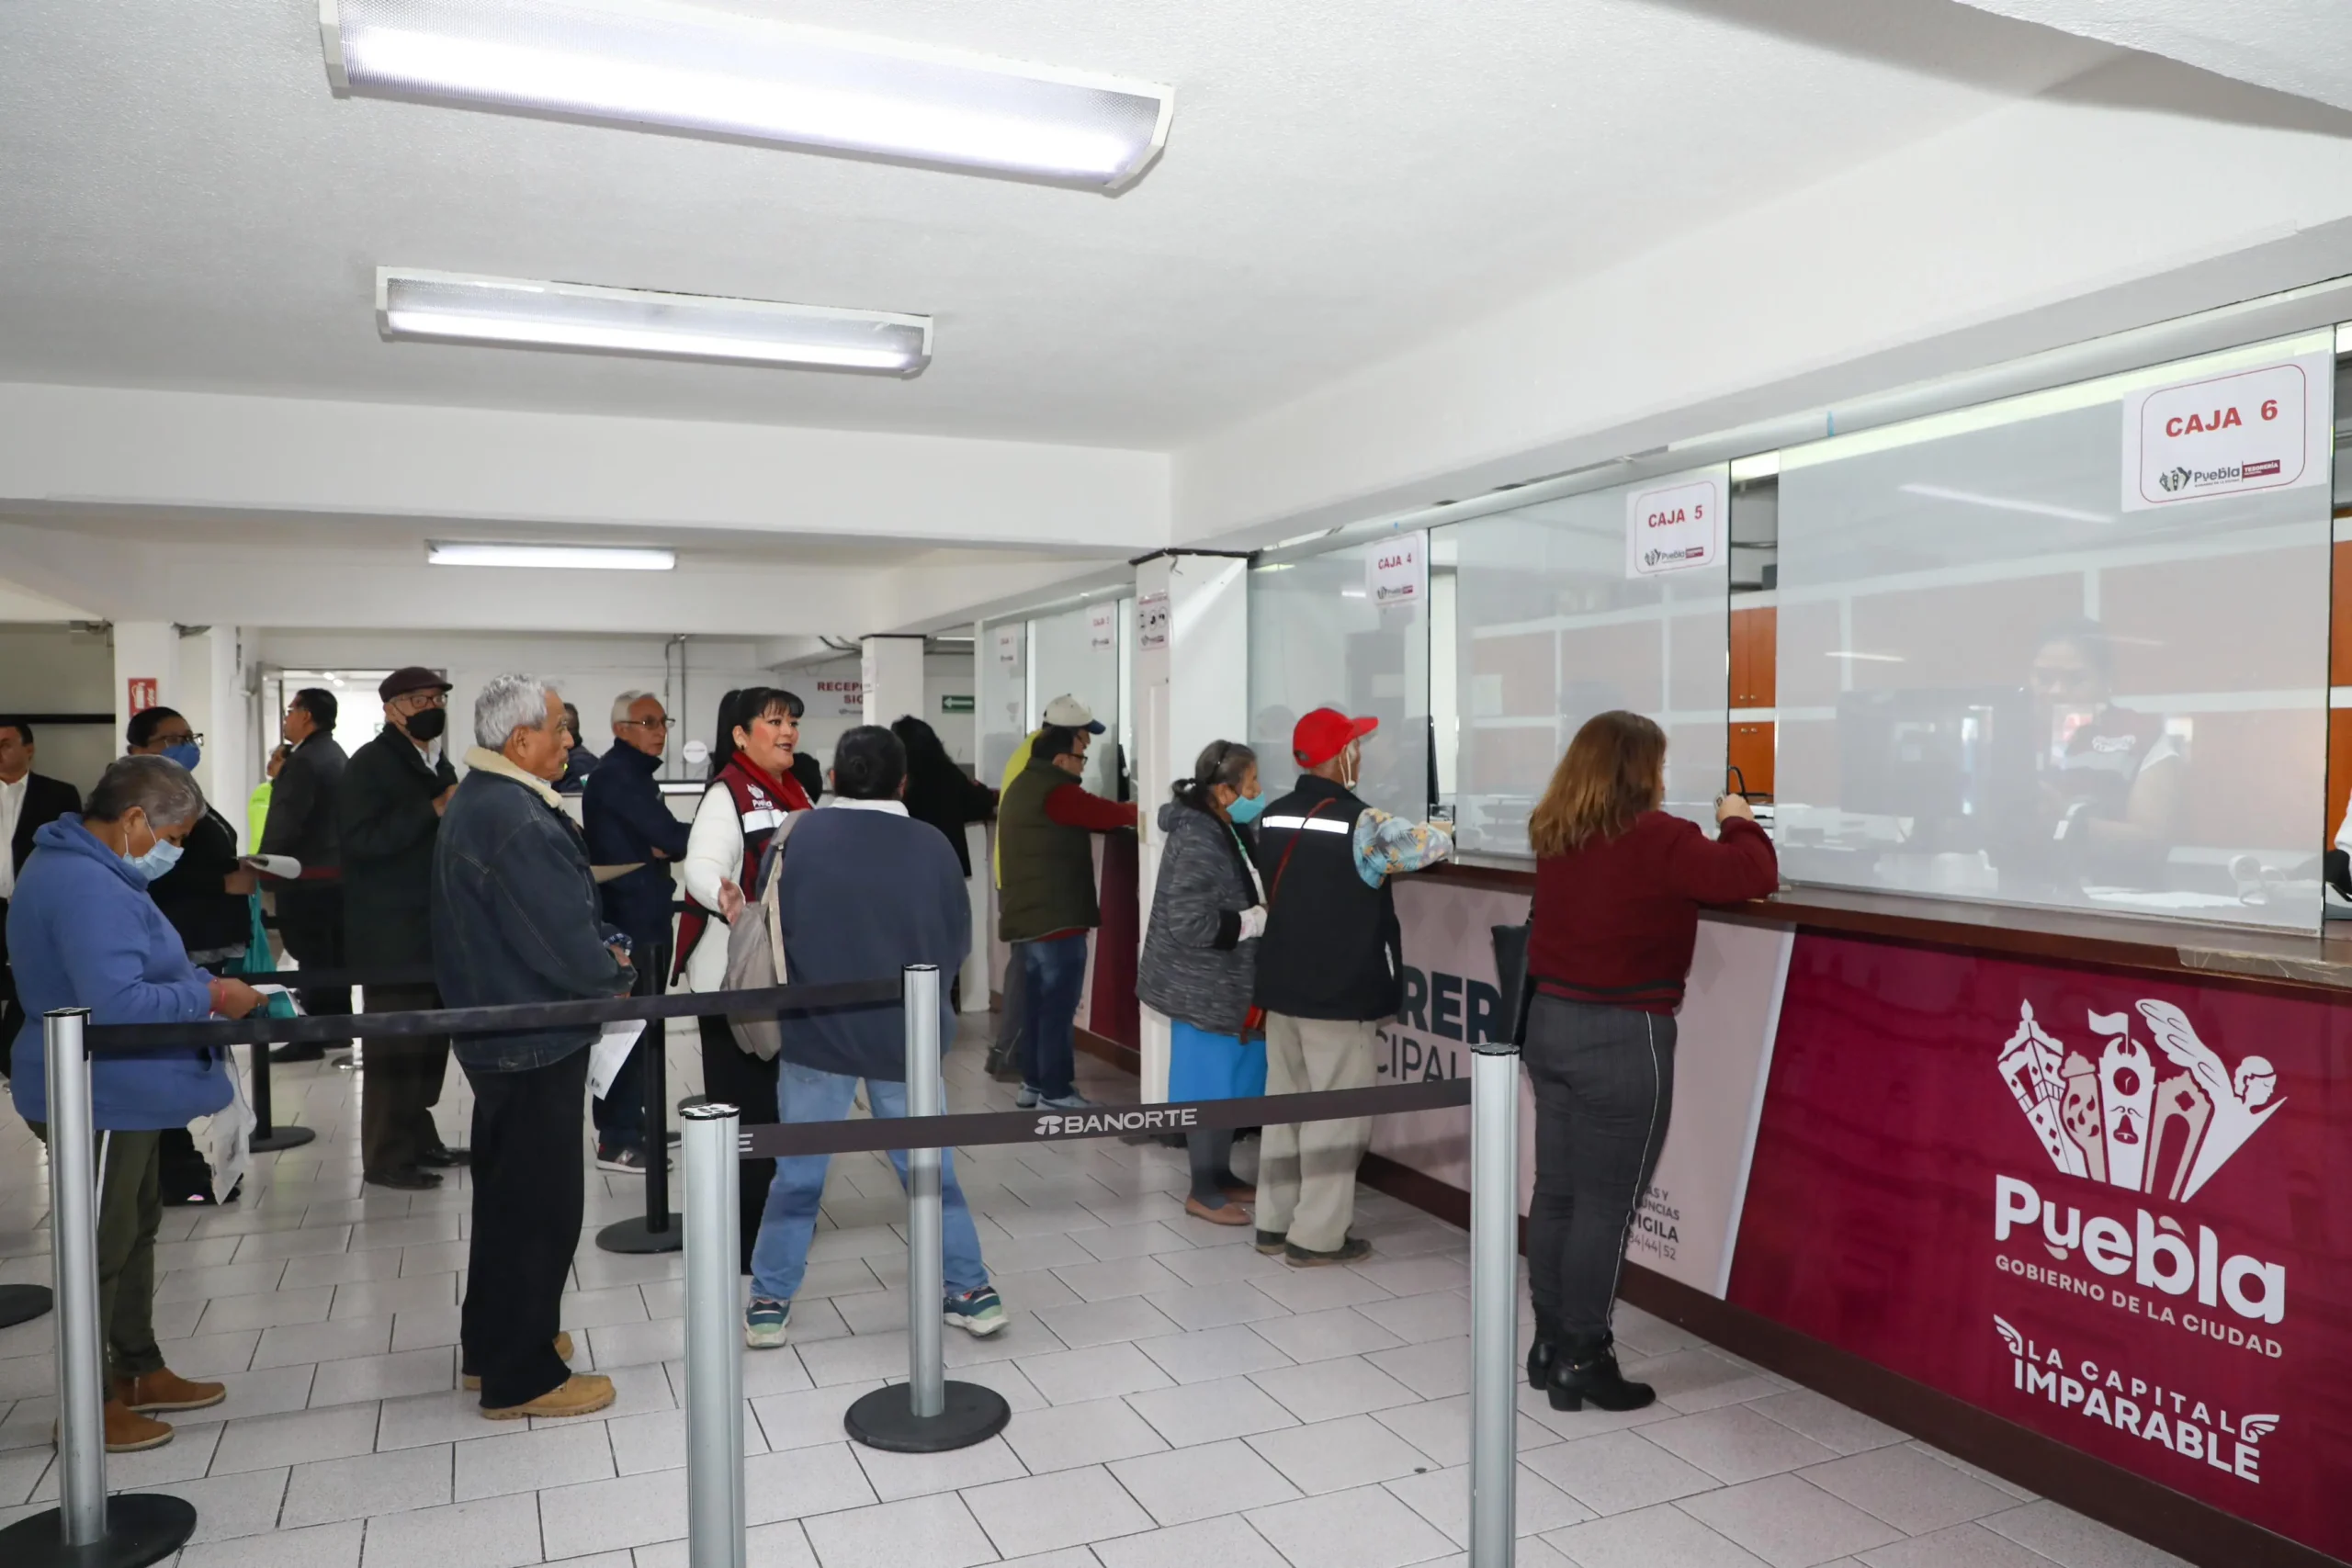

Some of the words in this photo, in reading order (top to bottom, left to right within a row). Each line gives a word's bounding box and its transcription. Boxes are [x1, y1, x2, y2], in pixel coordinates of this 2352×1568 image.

[2165, 407, 2242, 437] CAJA
[2260, 400, 2278, 421] 6
[2194, 467, 2240, 482] Puebla
[1648, 508, 1685, 528] CAJA
[1694, 504, 1702, 520] 5
[1378, 555, 1402, 570] CAJA
[1407, 552, 1412, 563] 4
[1064, 1108, 1197, 1134] BANORTE
[1662, 1190, 1668, 1201] Y
[1995, 1174, 2287, 1325] Puebla
[1996, 1254, 2105, 1301] GOBIERNO
[2112, 1291, 2140, 1314] DE
[2147, 1302, 2176, 1325] LA
[2182, 1314, 2282, 1359] CIUDAD
[2028, 1339, 2064, 1370] LA
[2080, 1360, 2235, 1434] CAPITAL
[2015, 1358, 2260, 1484] IMPARABLE
